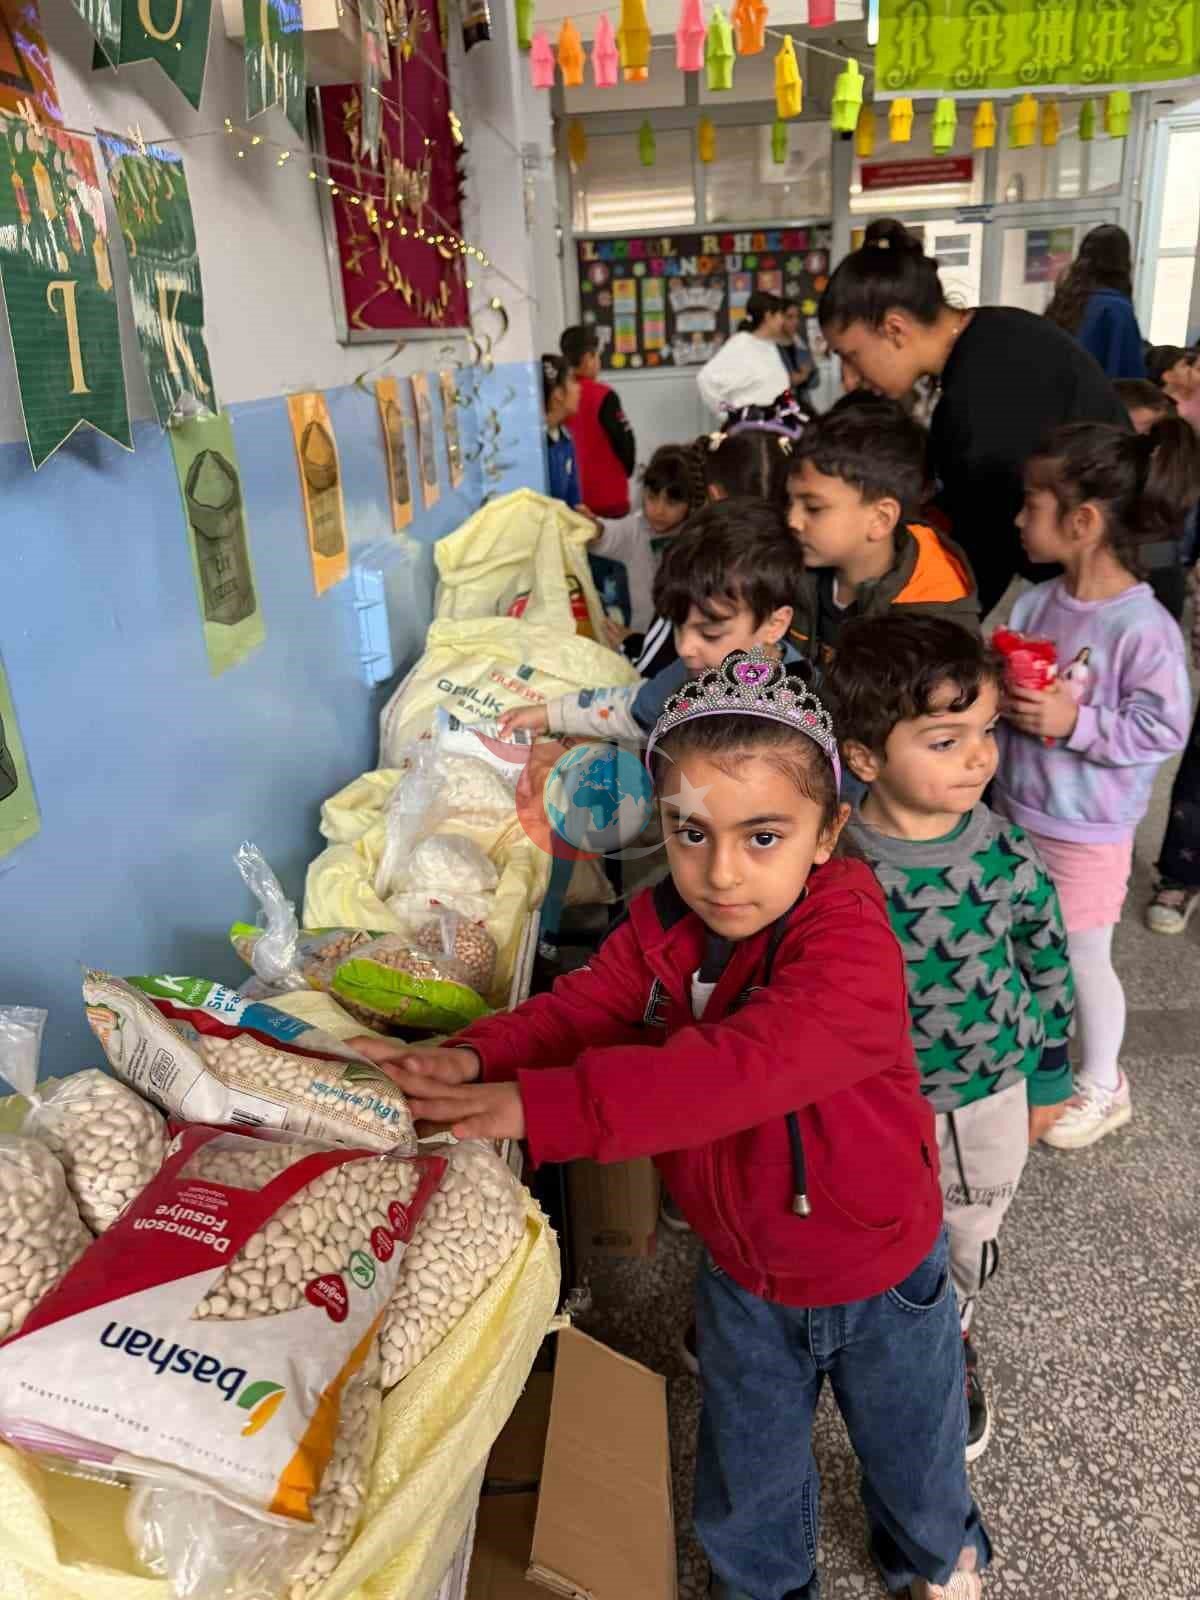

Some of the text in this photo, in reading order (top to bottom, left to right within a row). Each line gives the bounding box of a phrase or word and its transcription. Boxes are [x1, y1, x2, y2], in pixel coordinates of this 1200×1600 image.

[155, 1203, 228, 1232] Fasulye
[133, 1218, 232, 1253] Dermason
[99, 1321, 248, 1401] bashan
